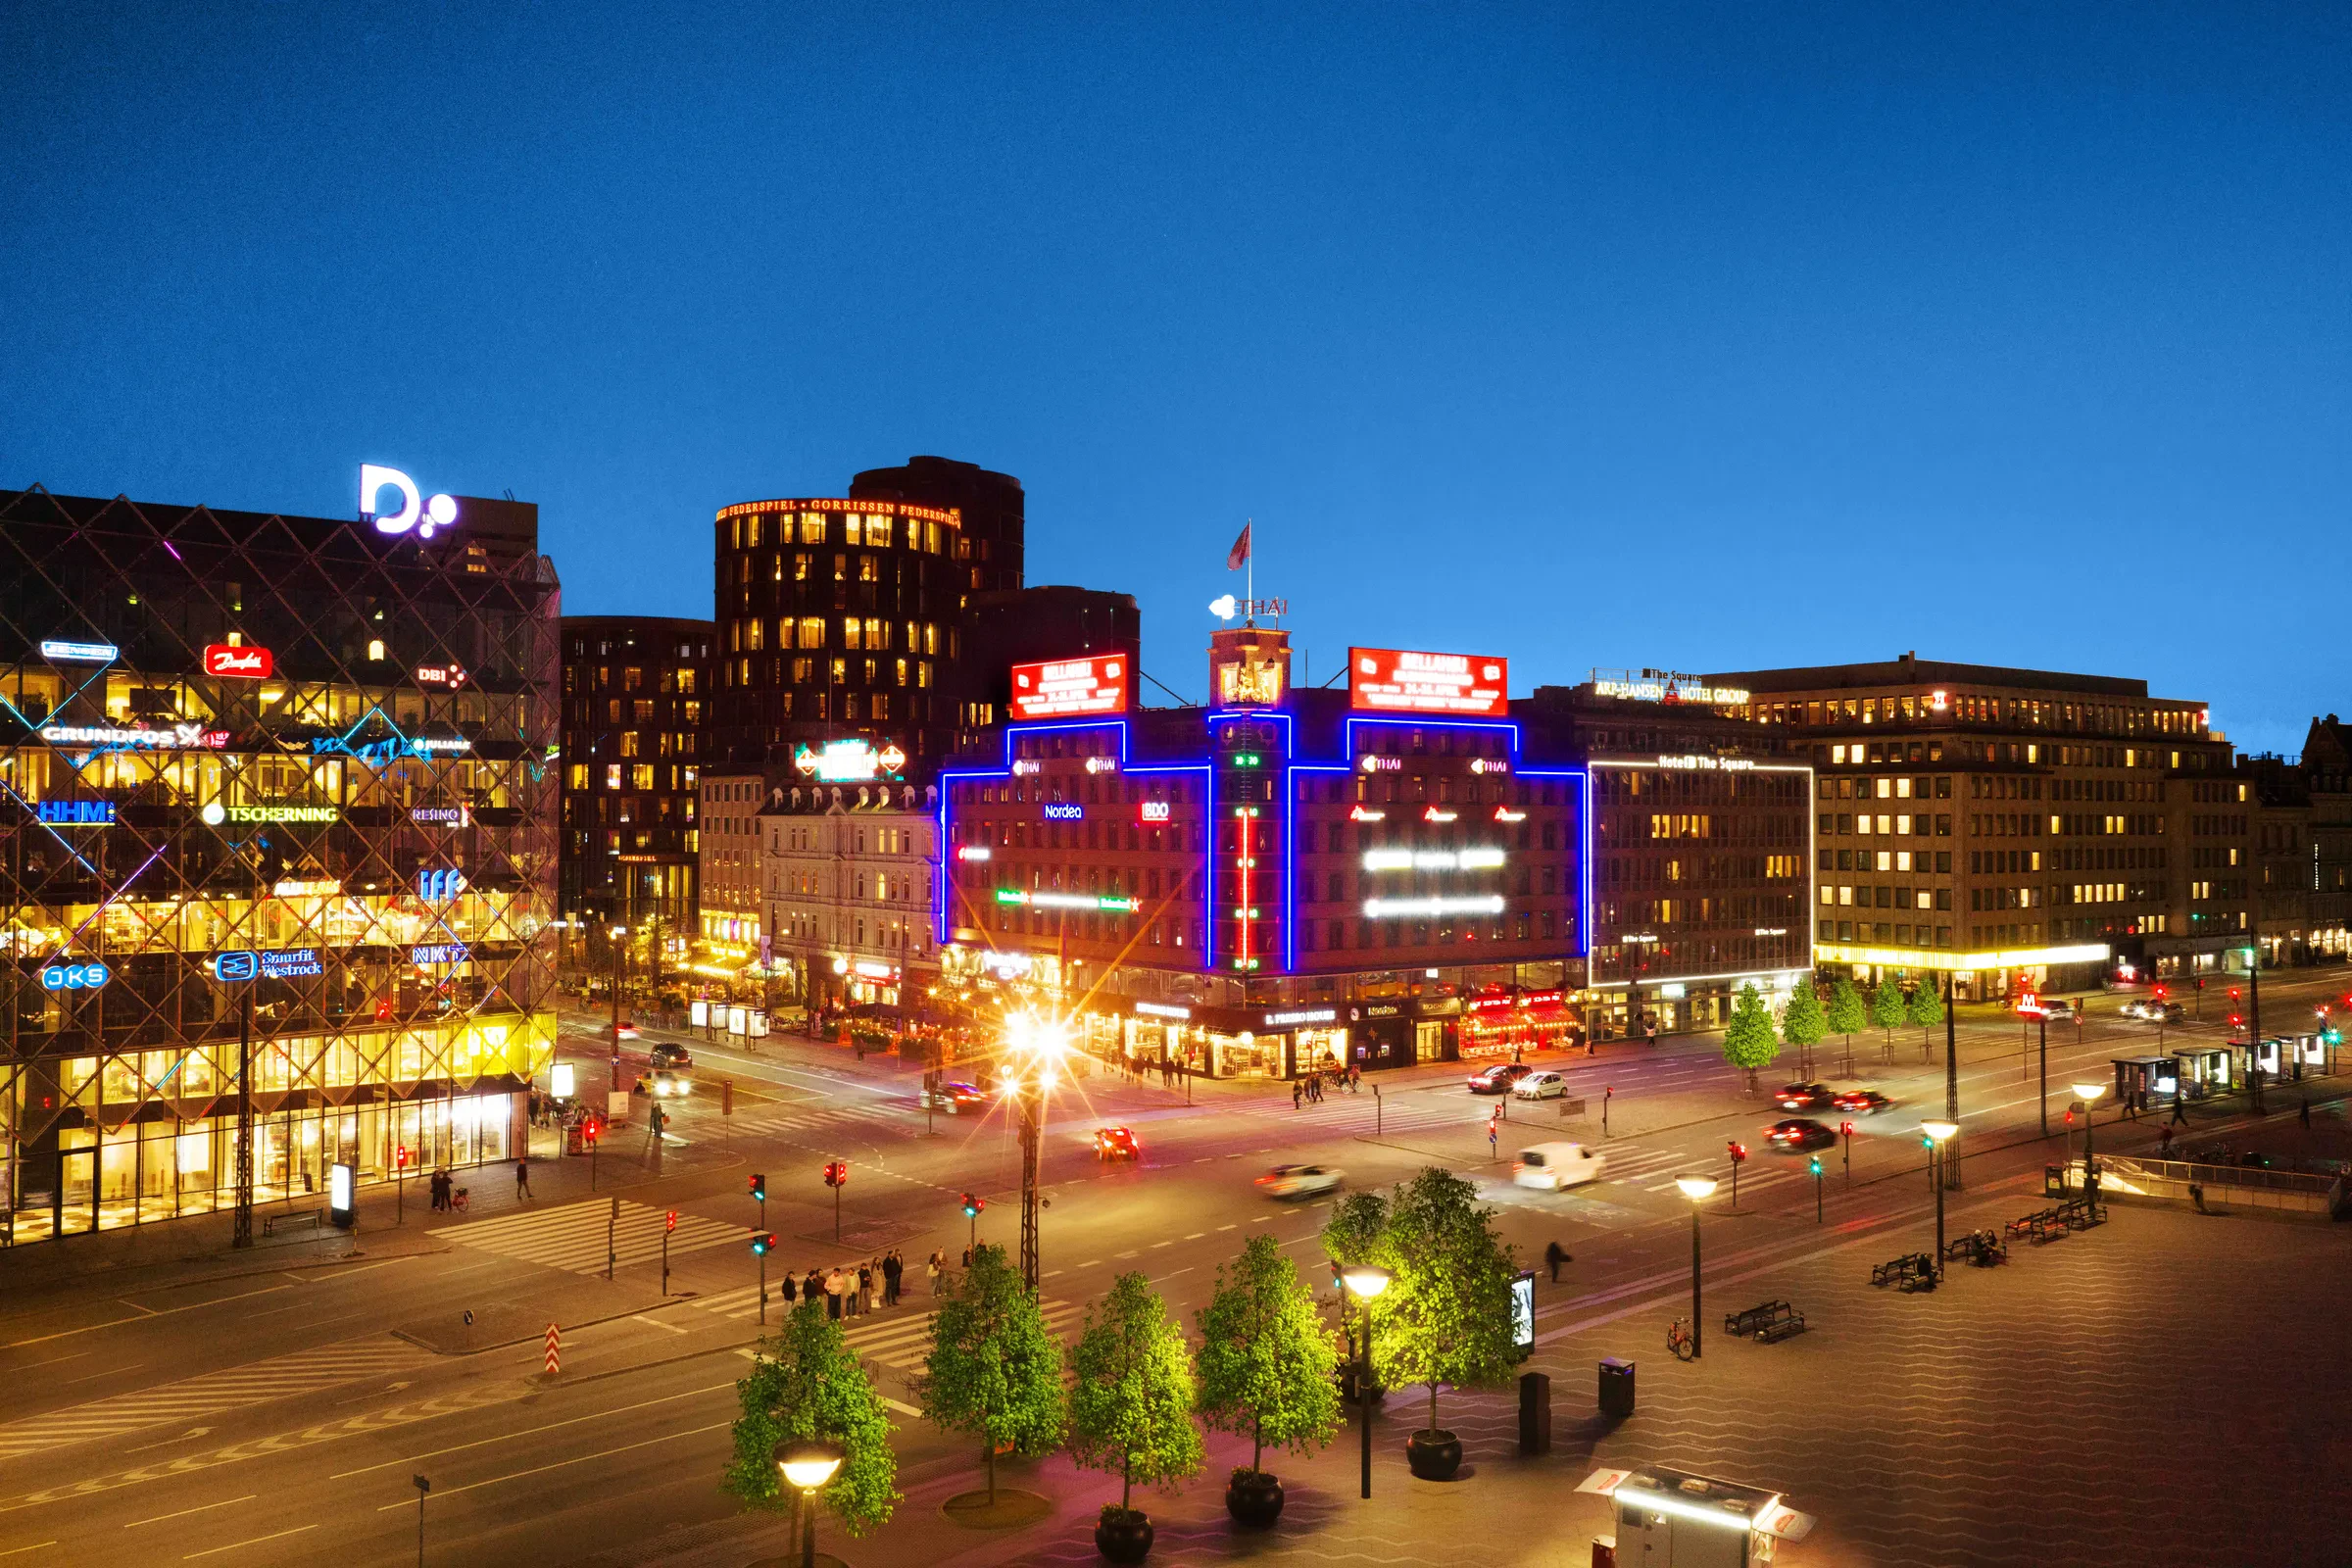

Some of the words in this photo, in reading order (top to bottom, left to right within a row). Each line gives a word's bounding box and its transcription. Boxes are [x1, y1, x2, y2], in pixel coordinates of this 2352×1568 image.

[729, 500, 796, 515] FEDERSPIEL
[811, 500, 895, 514] GORRISSEN
[900, 505, 956, 524] FEDERSPIEL
[1237, 599, 1288, 615] THAI
[418, 668, 446, 682] DBI
[1651, 669, 1668, 679] The
[1672, 670, 1702, 682] Square
[1595, 682, 1664, 698] ARP-HANSEN
[1680, 687, 1713, 701] HOTEL
[1714, 689, 1749, 704] GROUP
[42, 726, 175, 746] GRUNDFOS
[424, 740, 470, 750] JULIANA
[1022, 762, 1040, 773] THAI
[1096, 760, 1115, 771] THAI
[1376, 759, 1401, 770] THAI
[1483, 760, 1507, 772] THAI
[1659, 756, 1688, 769] Hotel
[1697, 757, 1717, 769] The
[1719, 758, 1754, 771] Square
[39, 801, 106, 822] HHM
[228, 808, 338, 821] TSCHERNING
[413, 808, 459, 821] RESINO
[1045, 804, 1082, 818] Nordea
[1145, 803, 1169, 817] BDO
[262, 949, 315, 964] Smurfit
[413, 945, 465, 963] NKT
[262, 962, 322, 977] Westrock
[1306, 1010, 1336, 1022] HOUSE
